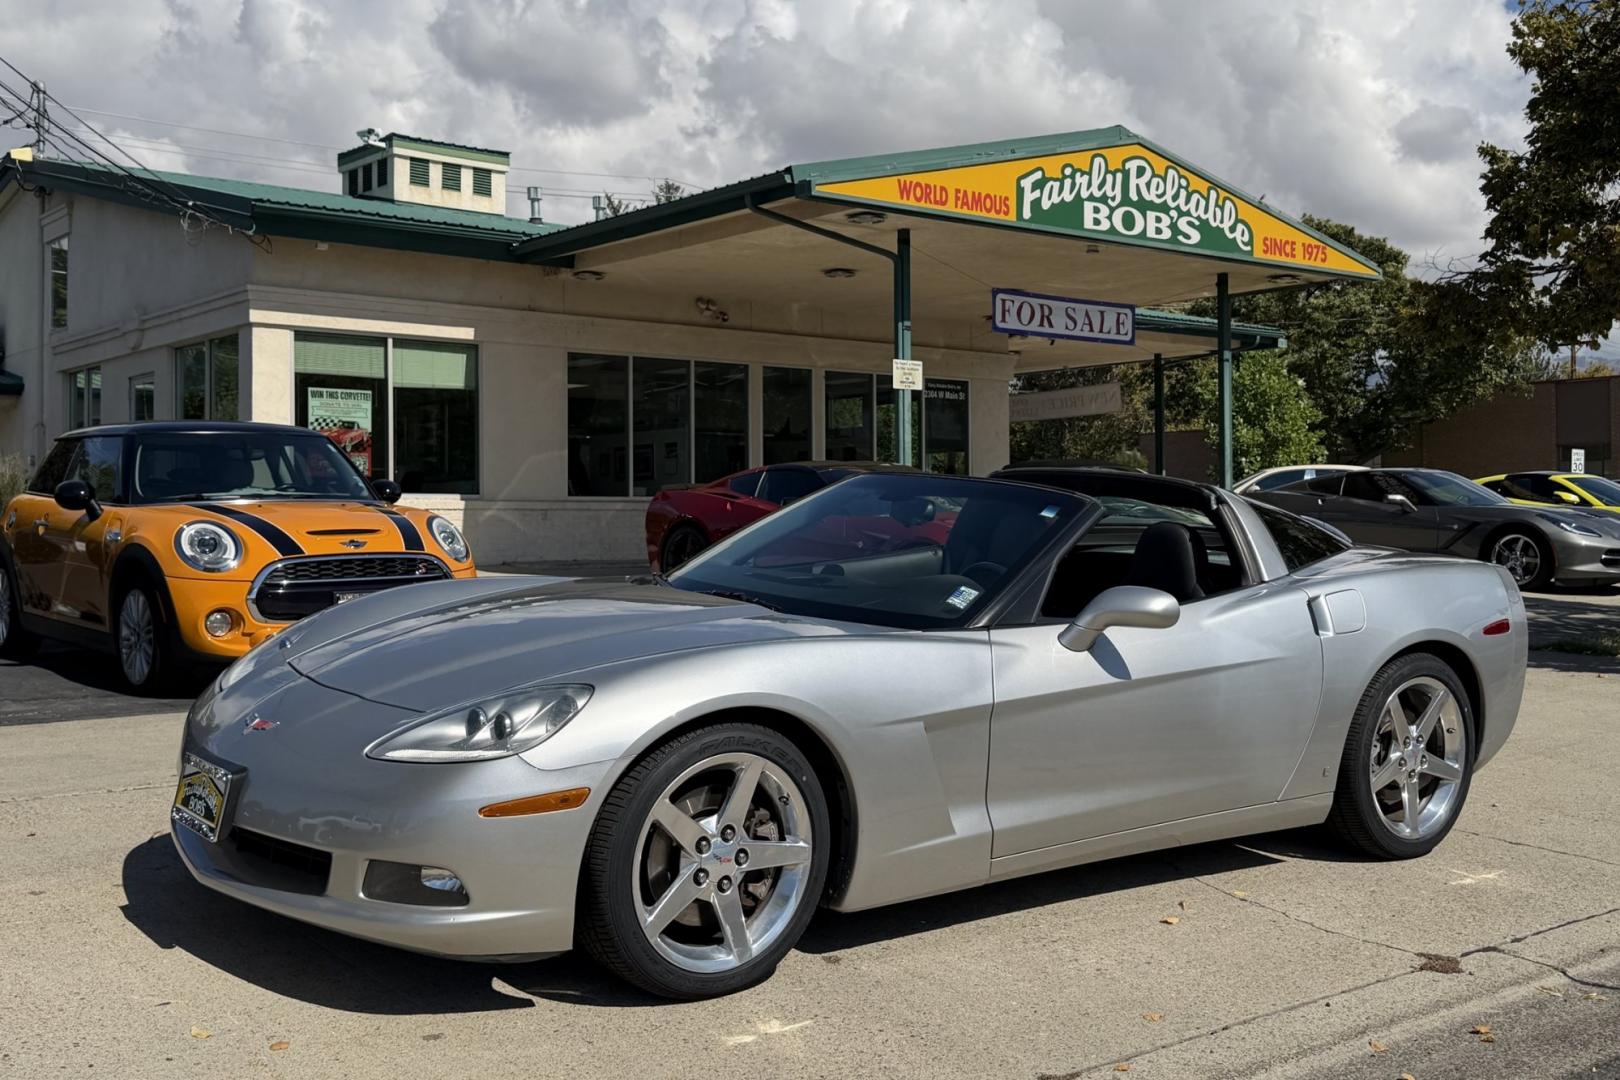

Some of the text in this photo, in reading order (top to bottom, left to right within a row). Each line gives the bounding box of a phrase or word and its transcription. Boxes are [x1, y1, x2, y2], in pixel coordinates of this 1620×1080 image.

[897, 178, 1010, 217] WORLD FAMOUS
[1020, 156, 1252, 251] Fairly Reliable
[1083, 200, 1201, 245] BOB'S
[1262, 236, 1328, 264] SINCE 1975
[999, 298, 1130, 337] FOR SALE
[310, 390, 371, 401] WIN THIS CORVETTE!
[938, 390, 945, 399] W
[945, 391, 959, 400] Main
[1573, 462, 1583, 472] 30
